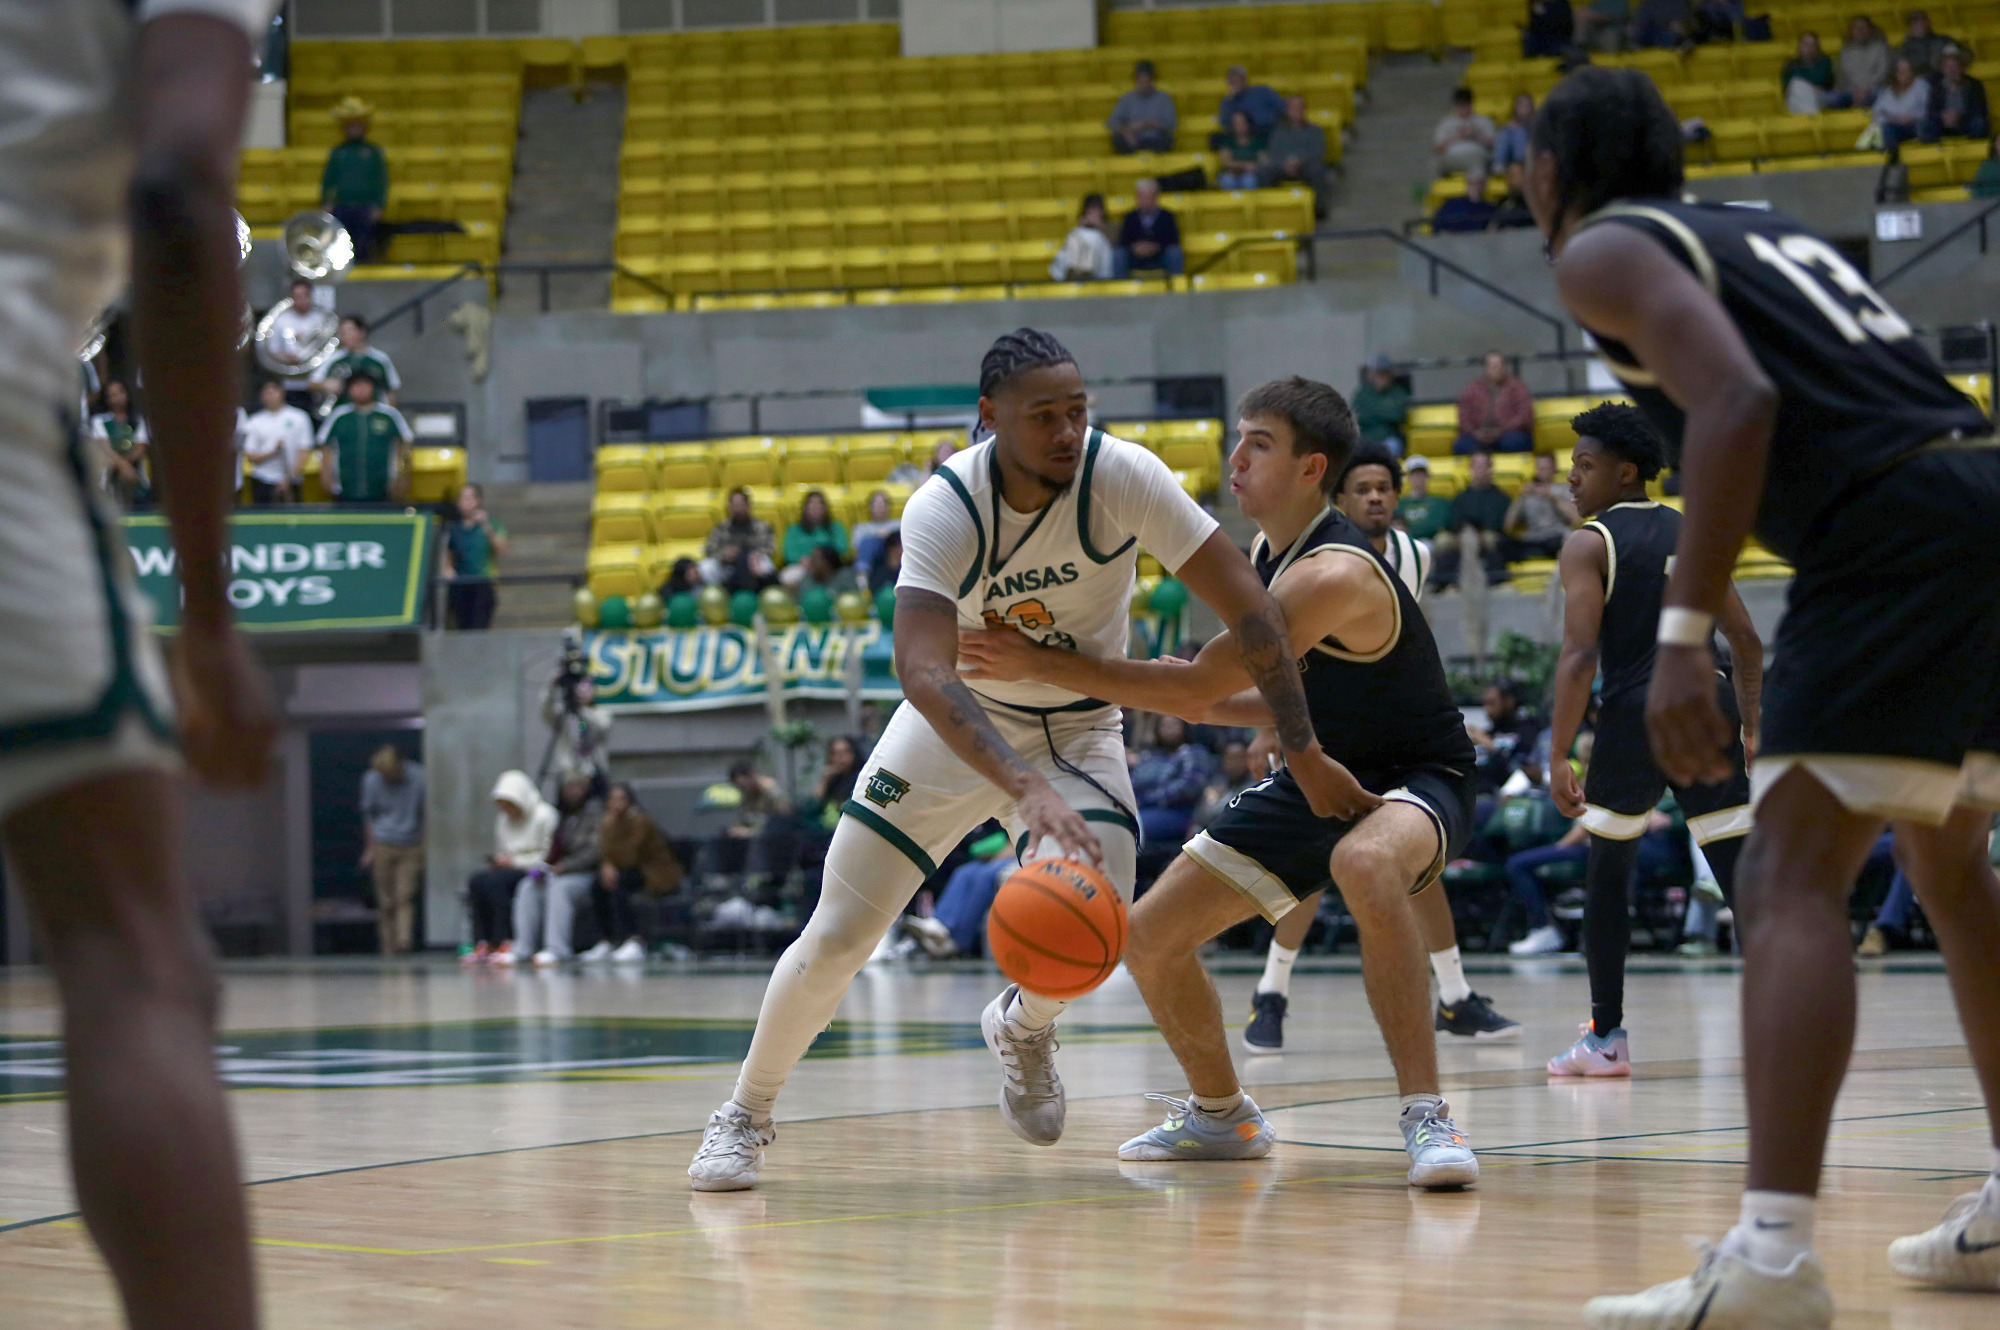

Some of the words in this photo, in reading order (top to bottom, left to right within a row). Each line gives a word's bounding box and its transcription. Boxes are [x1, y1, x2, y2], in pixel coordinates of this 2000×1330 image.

[1744, 231, 1912, 343] 13
[129, 541, 386, 577] WNDER
[179, 575, 336, 609] OYS
[983, 562, 1079, 602] ANSAS
[870, 776, 902, 801] TECH
